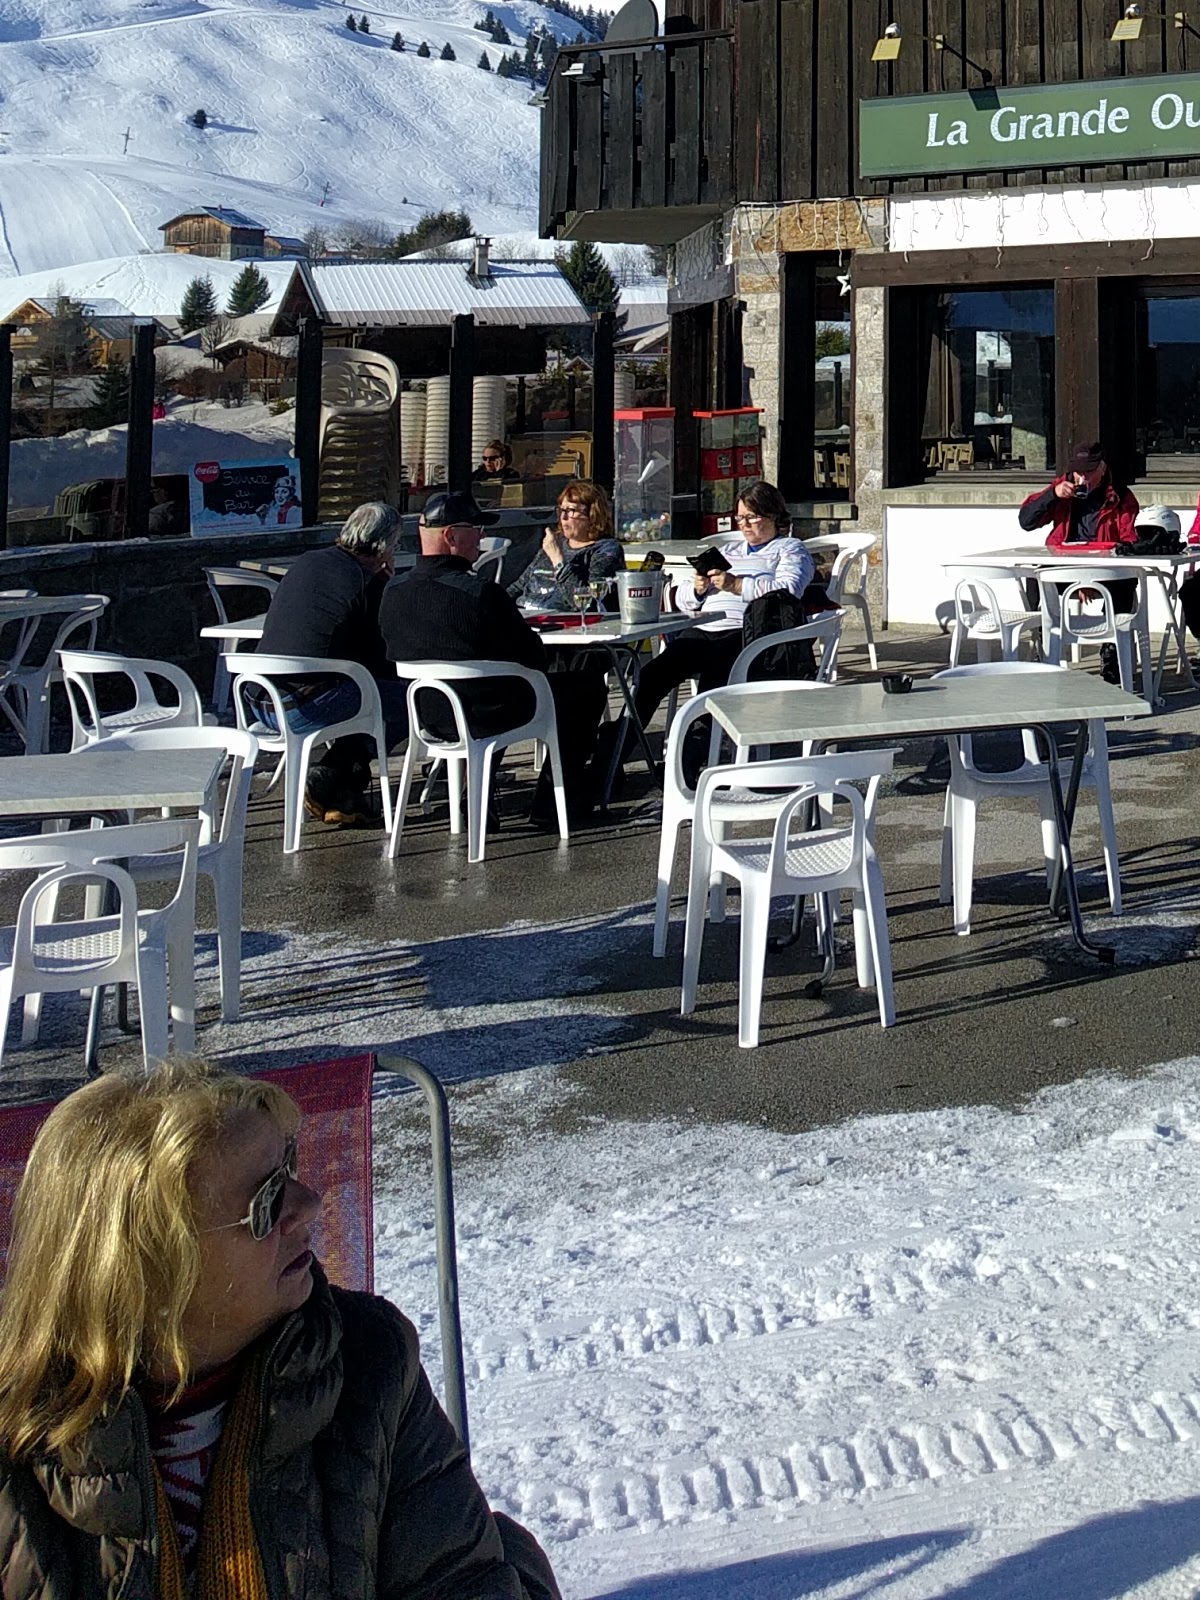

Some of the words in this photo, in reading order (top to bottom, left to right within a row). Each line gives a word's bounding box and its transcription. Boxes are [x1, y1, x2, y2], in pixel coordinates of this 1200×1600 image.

[926, 112, 969, 148] La
[990, 98, 1130, 143] Grande
[222, 470, 271, 486] Service
[235, 489, 250, 498] au
[224, 499, 254, 511] Bar
[630, 589, 651, 597] PIPER
